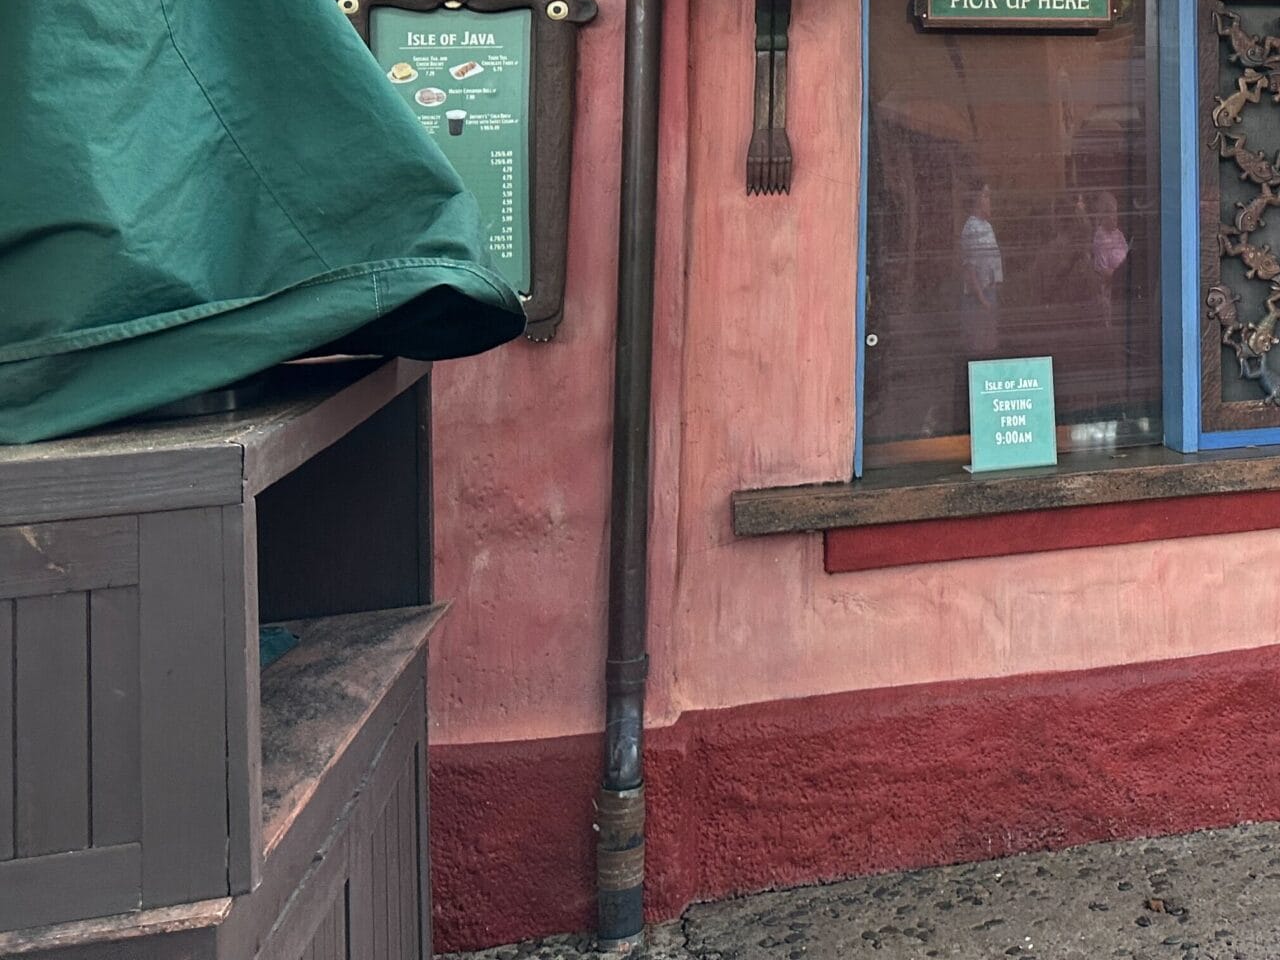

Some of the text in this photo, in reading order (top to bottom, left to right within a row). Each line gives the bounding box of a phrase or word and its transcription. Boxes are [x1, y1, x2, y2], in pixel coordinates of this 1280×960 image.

[407, 31, 495, 46] ISLE OF JAVA
[985, 378, 1038, 391] ISLE OF JAVA
[993, 399, 1032, 412] SERVING
[1000, 415, 1026, 427] FROM
[995, 431, 1033, 445] 9:00AM
